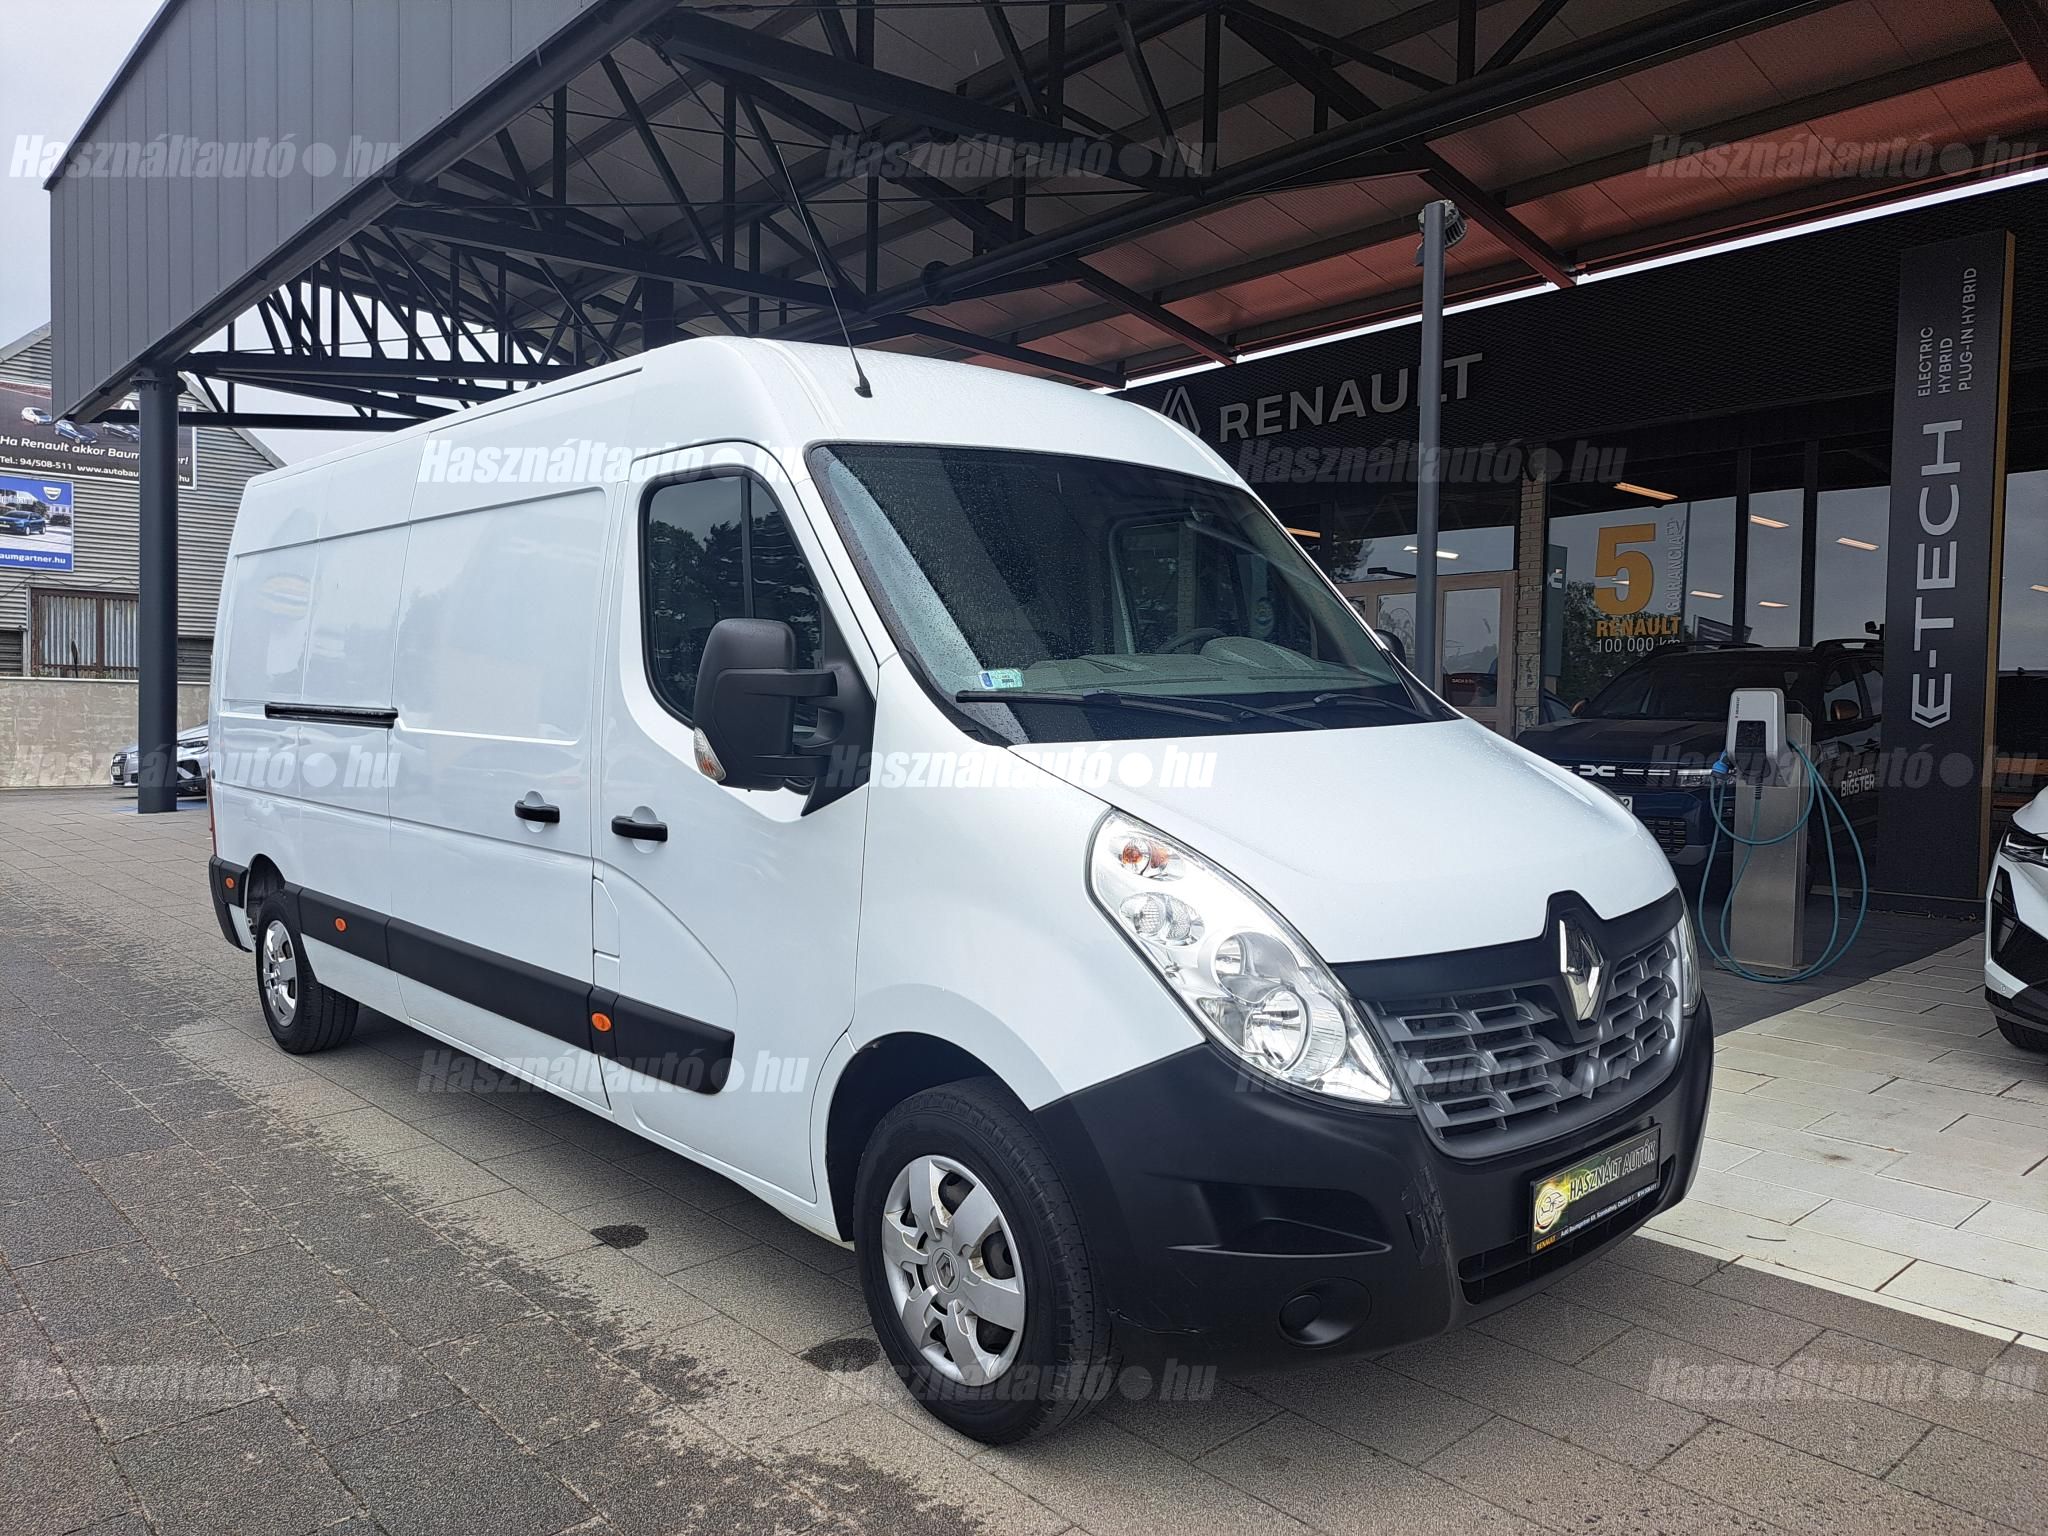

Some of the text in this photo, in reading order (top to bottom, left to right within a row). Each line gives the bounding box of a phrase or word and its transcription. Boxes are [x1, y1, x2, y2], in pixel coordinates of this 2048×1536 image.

[1958, 268, 1977, 391] PLUG-IN HYBRID
[1918, 326, 1933, 397] ELECTRIC
[1938, 338, 1953, 394] HYBRID
[0, 436, 18, 446] Ha
[21, 438, 69, 452] Renault
[72, 444, 106, 456] akkor
[0, 456, 18, 465] Tel.:
[20, 458, 72, 470] 94/508-511
[1594, 523, 1656, 616] 5
[1911, 419, 1963, 729] E-TECH
[1596, 616, 1681, 637] RENAULT
[1597, 639, 1622, 653] 100
[1627, 637, 1654, 652] 000
[1841, 774, 1875, 797] BIGSTER
[1848, 768, 1869, 778] DACIA
[1569, 1138, 1657, 1202] HASZNÁLT AUTÓK
